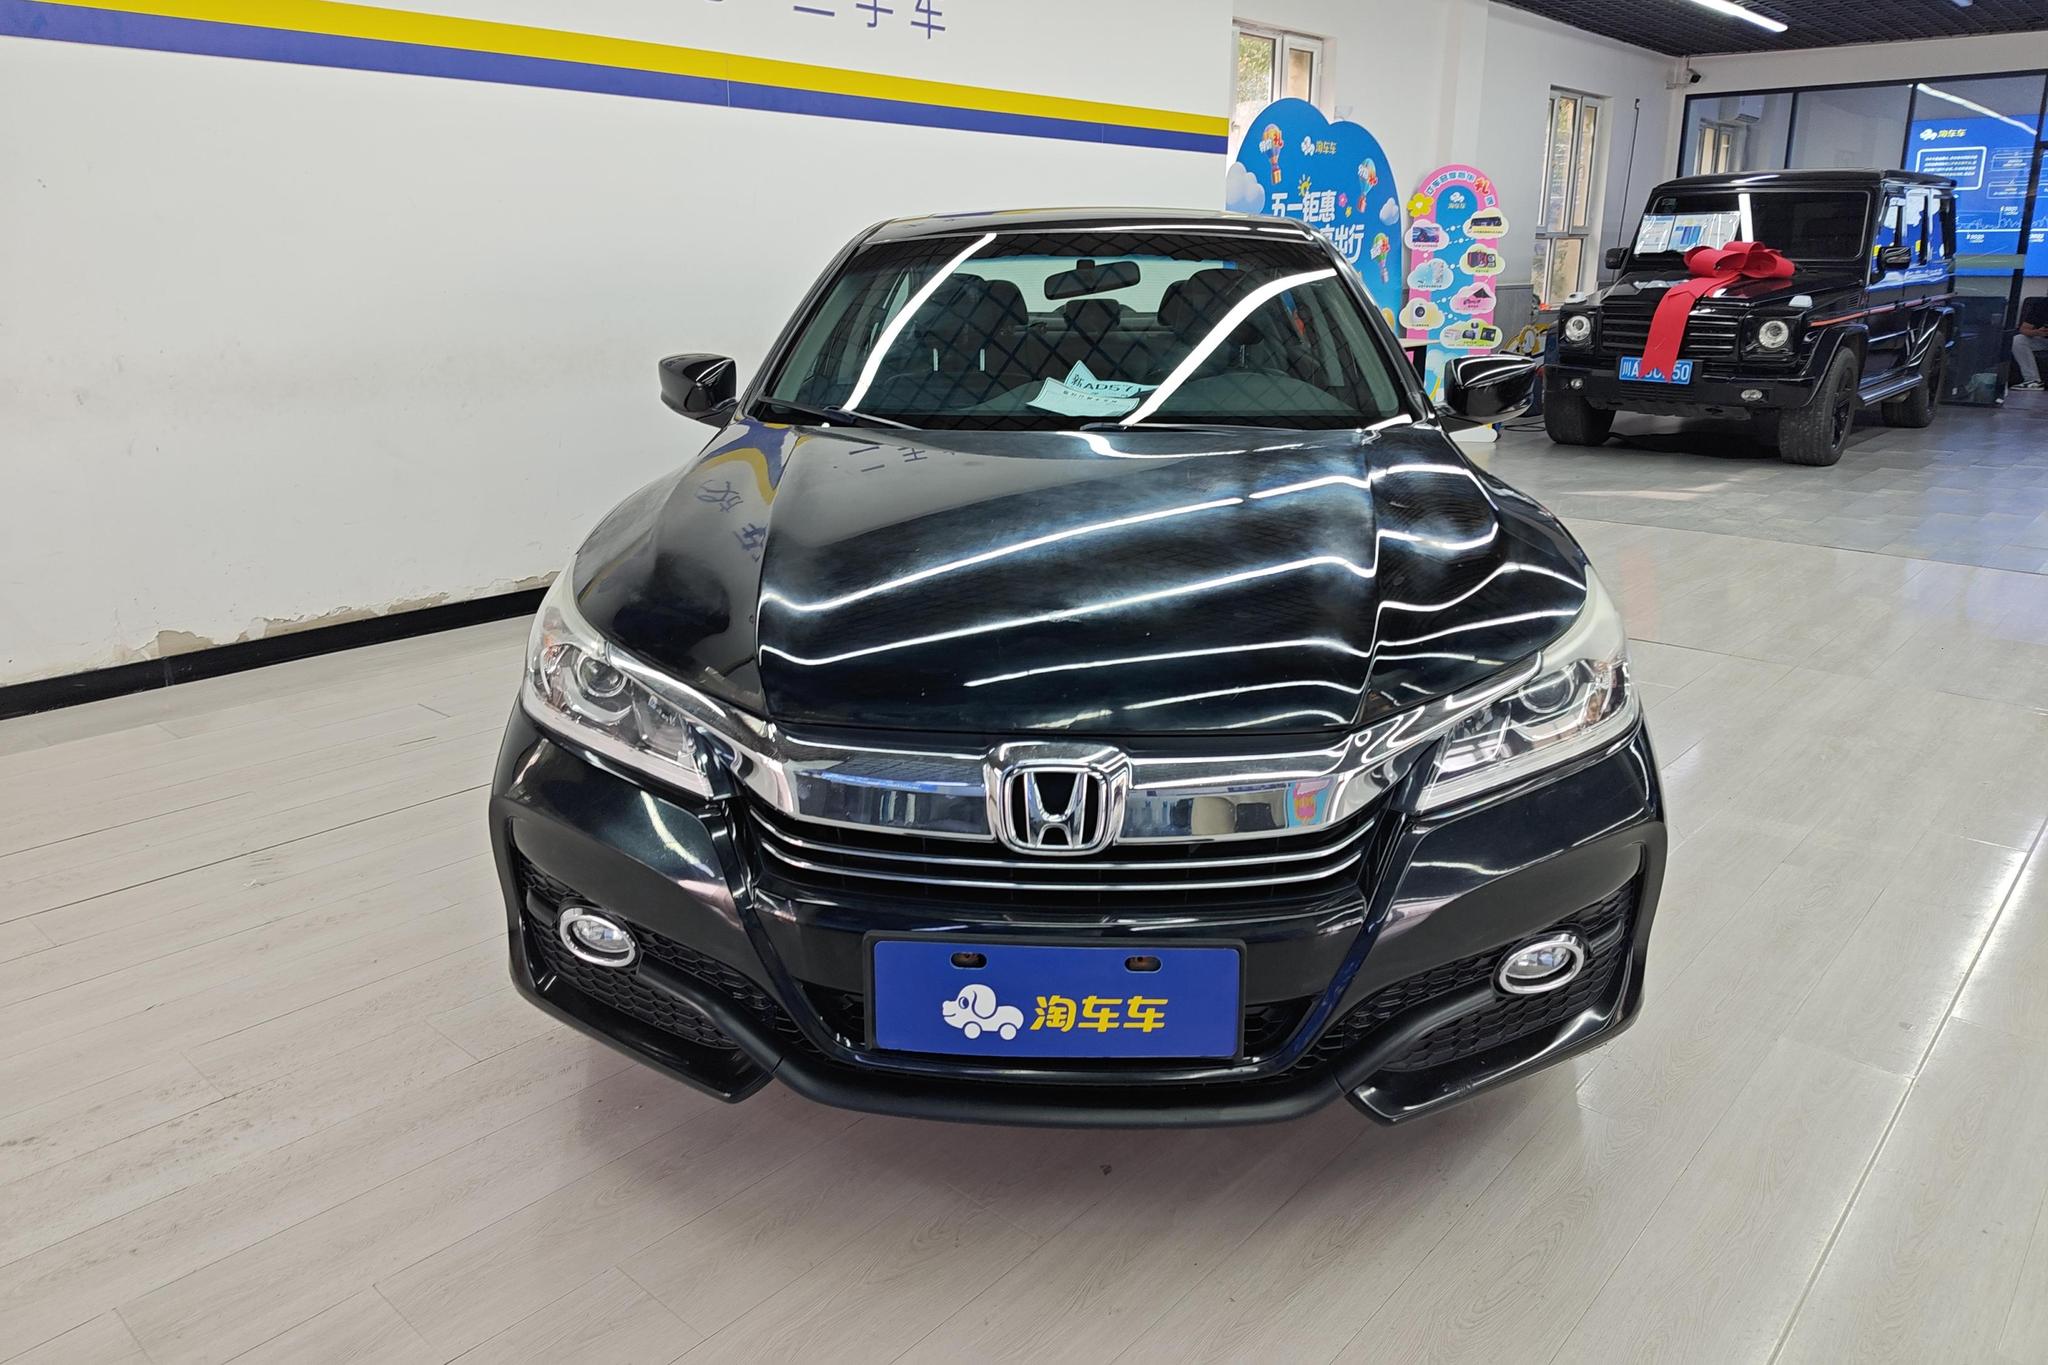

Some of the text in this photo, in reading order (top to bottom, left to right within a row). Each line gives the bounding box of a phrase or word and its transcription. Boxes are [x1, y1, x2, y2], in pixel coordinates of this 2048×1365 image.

[1271, 190, 1337, 222] 五一钜惠
[1622, 361, 1690, 381] 川A50
[1030, 995, 1168, 1033] 淘车车
